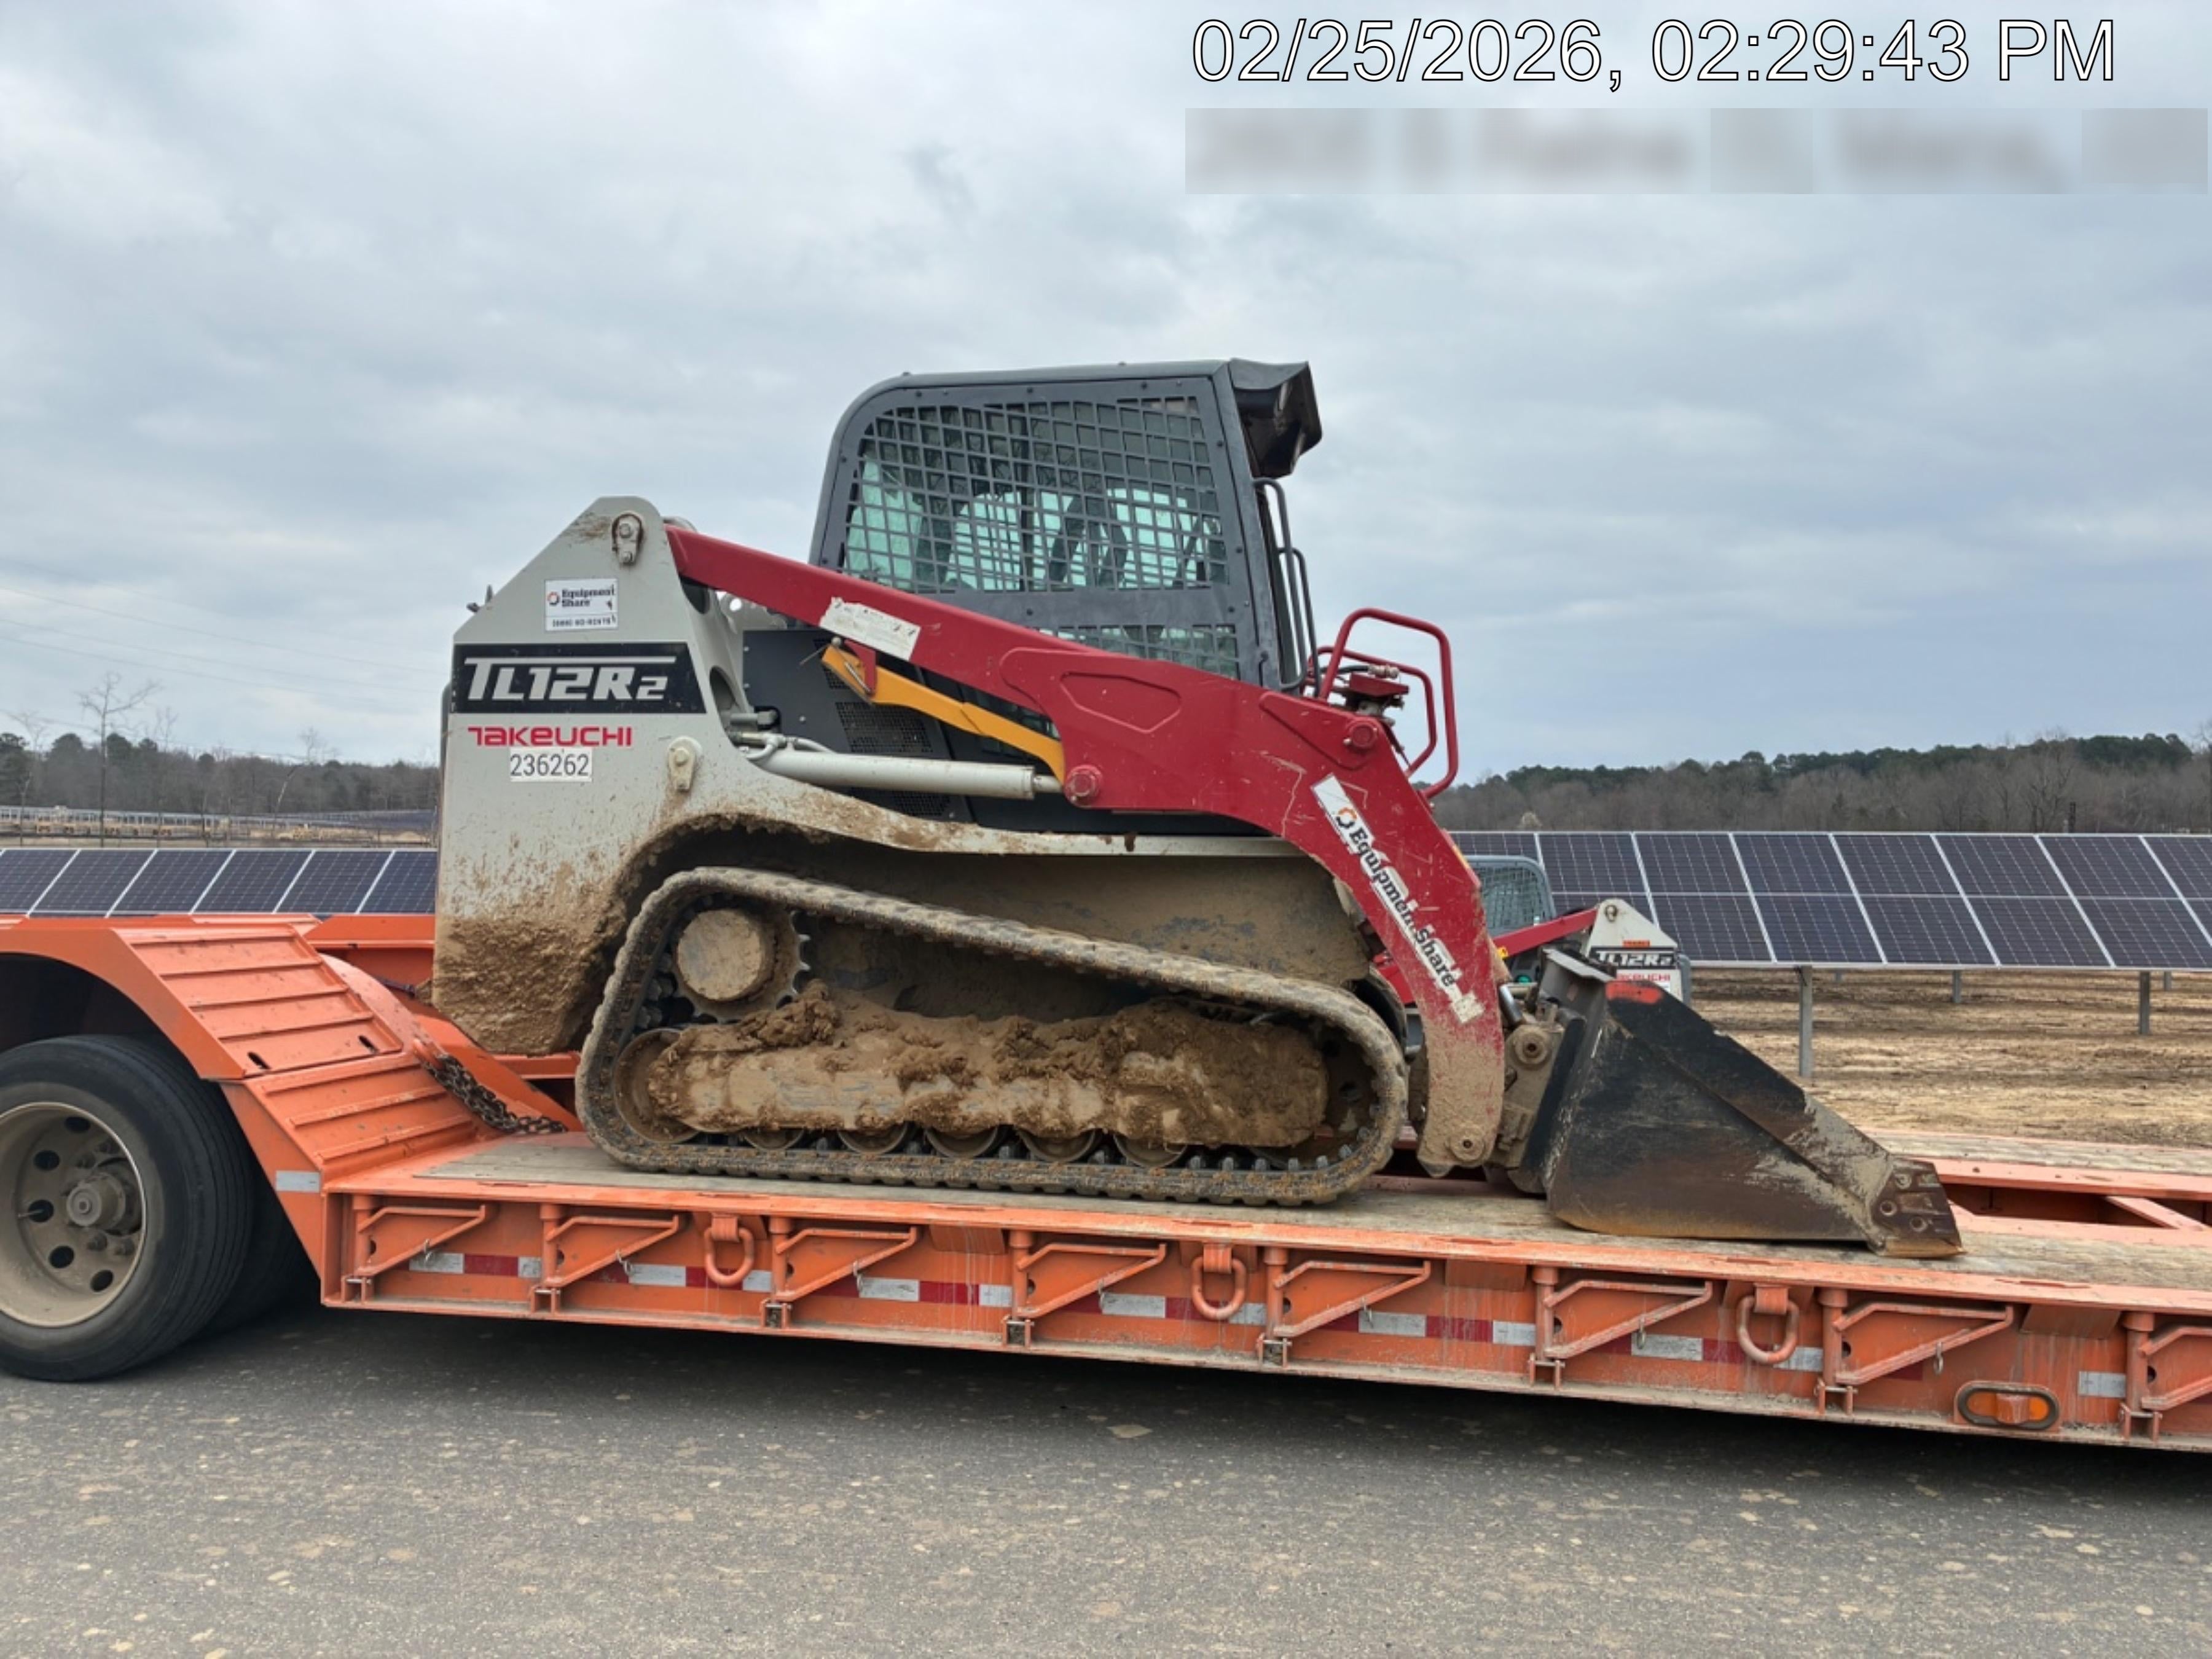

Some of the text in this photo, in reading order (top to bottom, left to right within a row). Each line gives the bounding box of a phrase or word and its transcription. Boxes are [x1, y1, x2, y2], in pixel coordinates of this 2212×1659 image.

[562, 586, 614, 599] Equipment
[464, 656, 676, 700] TL12R2
[509, 753, 589, 777] 236262
